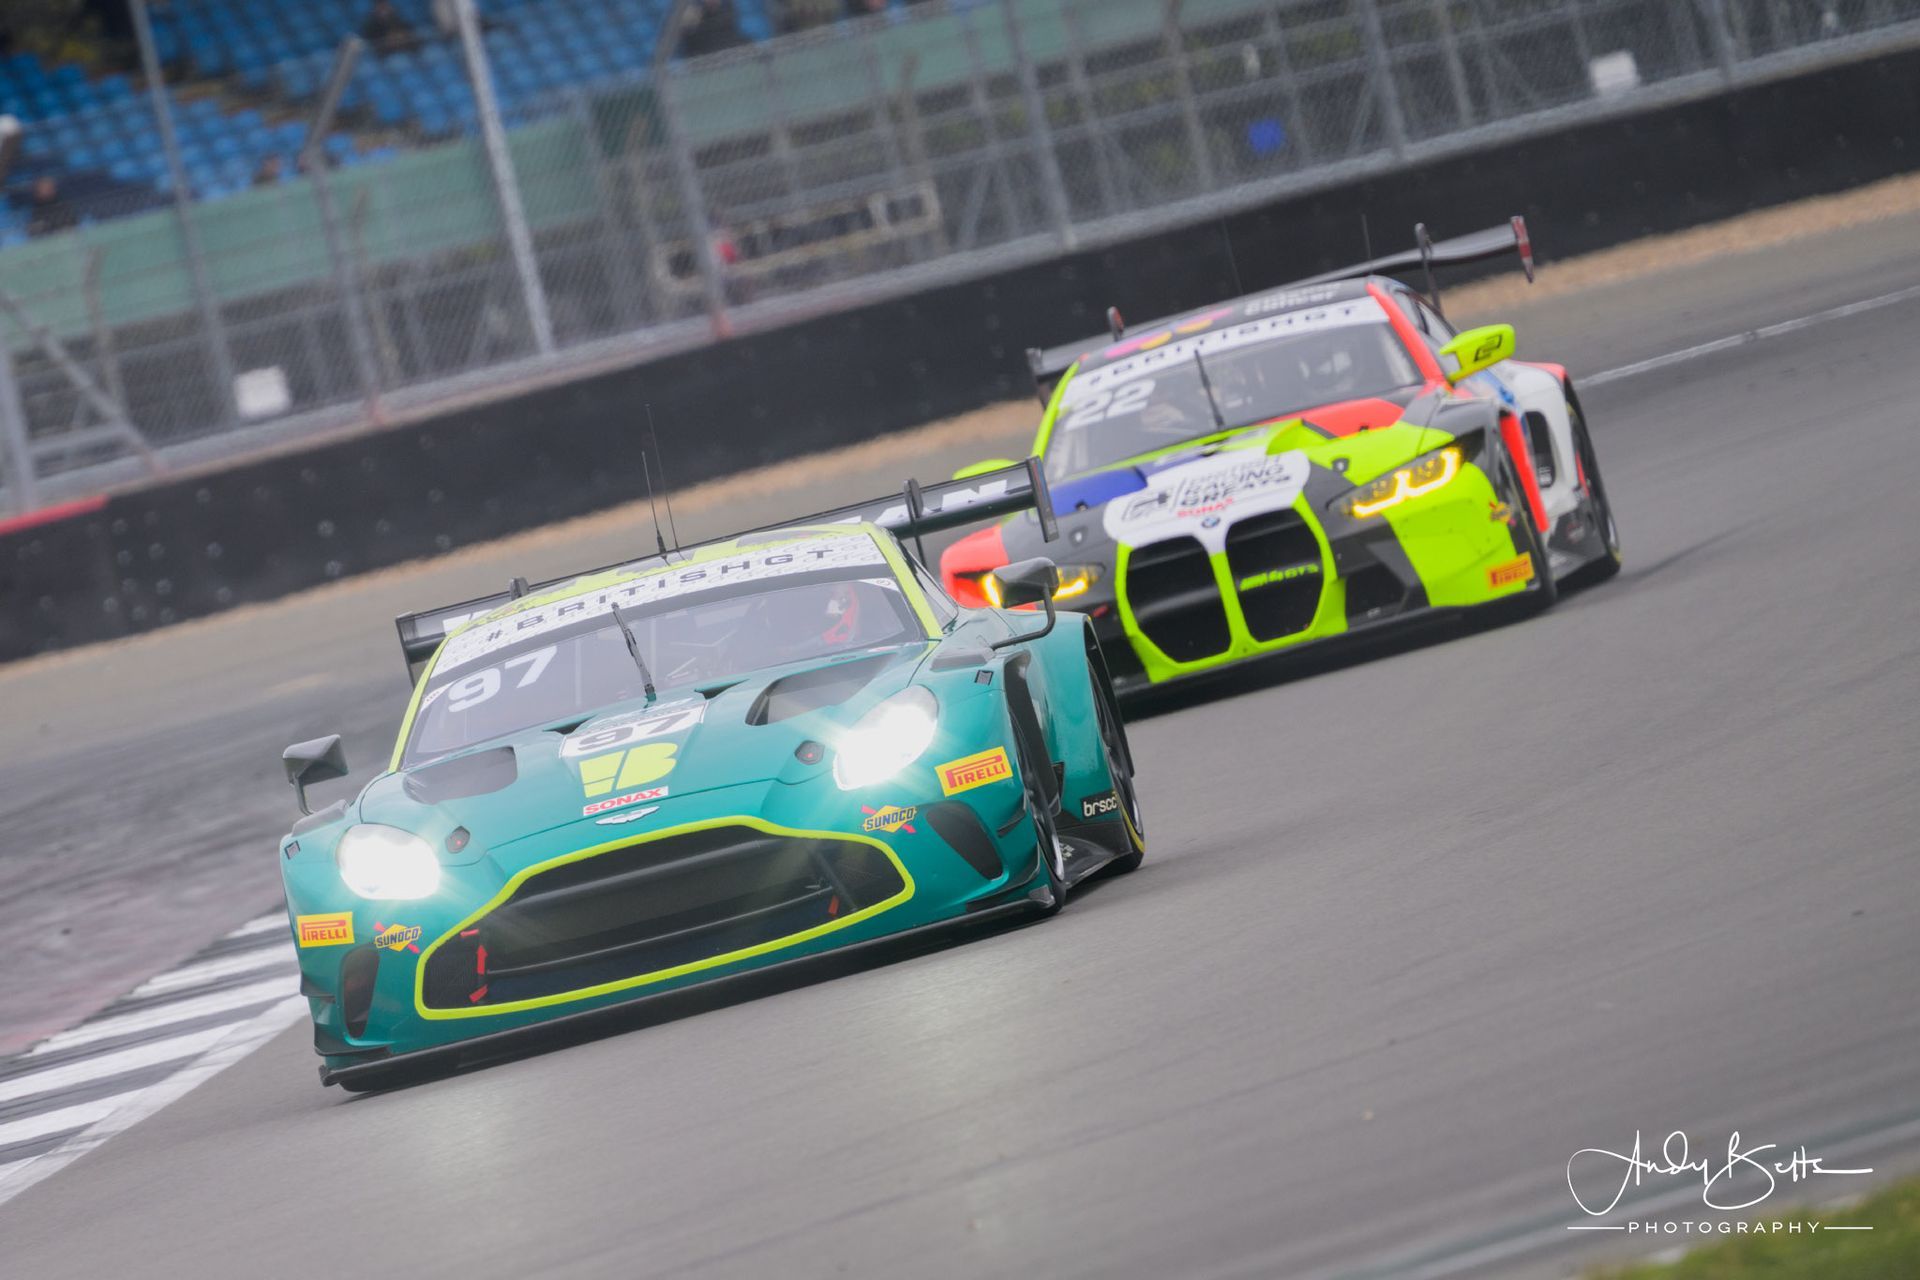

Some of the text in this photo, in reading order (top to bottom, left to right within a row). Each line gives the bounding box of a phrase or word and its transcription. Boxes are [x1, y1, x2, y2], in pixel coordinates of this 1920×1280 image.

[1063, 379, 1156, 432] 22
[486, 547, 836, 643] #BRITISHGT
[448, 645, 558, 713] 97
[578, 711, 691, 751] 97
[945, 754, 1007, 789] PIRELLI
[585, 788, 664, 815] SONAX
[864, 806, 917, 831] SUNOCO
[301, 918, 348, 942] PIRELLI
[375, 927, 422, 949] SUNOCO
